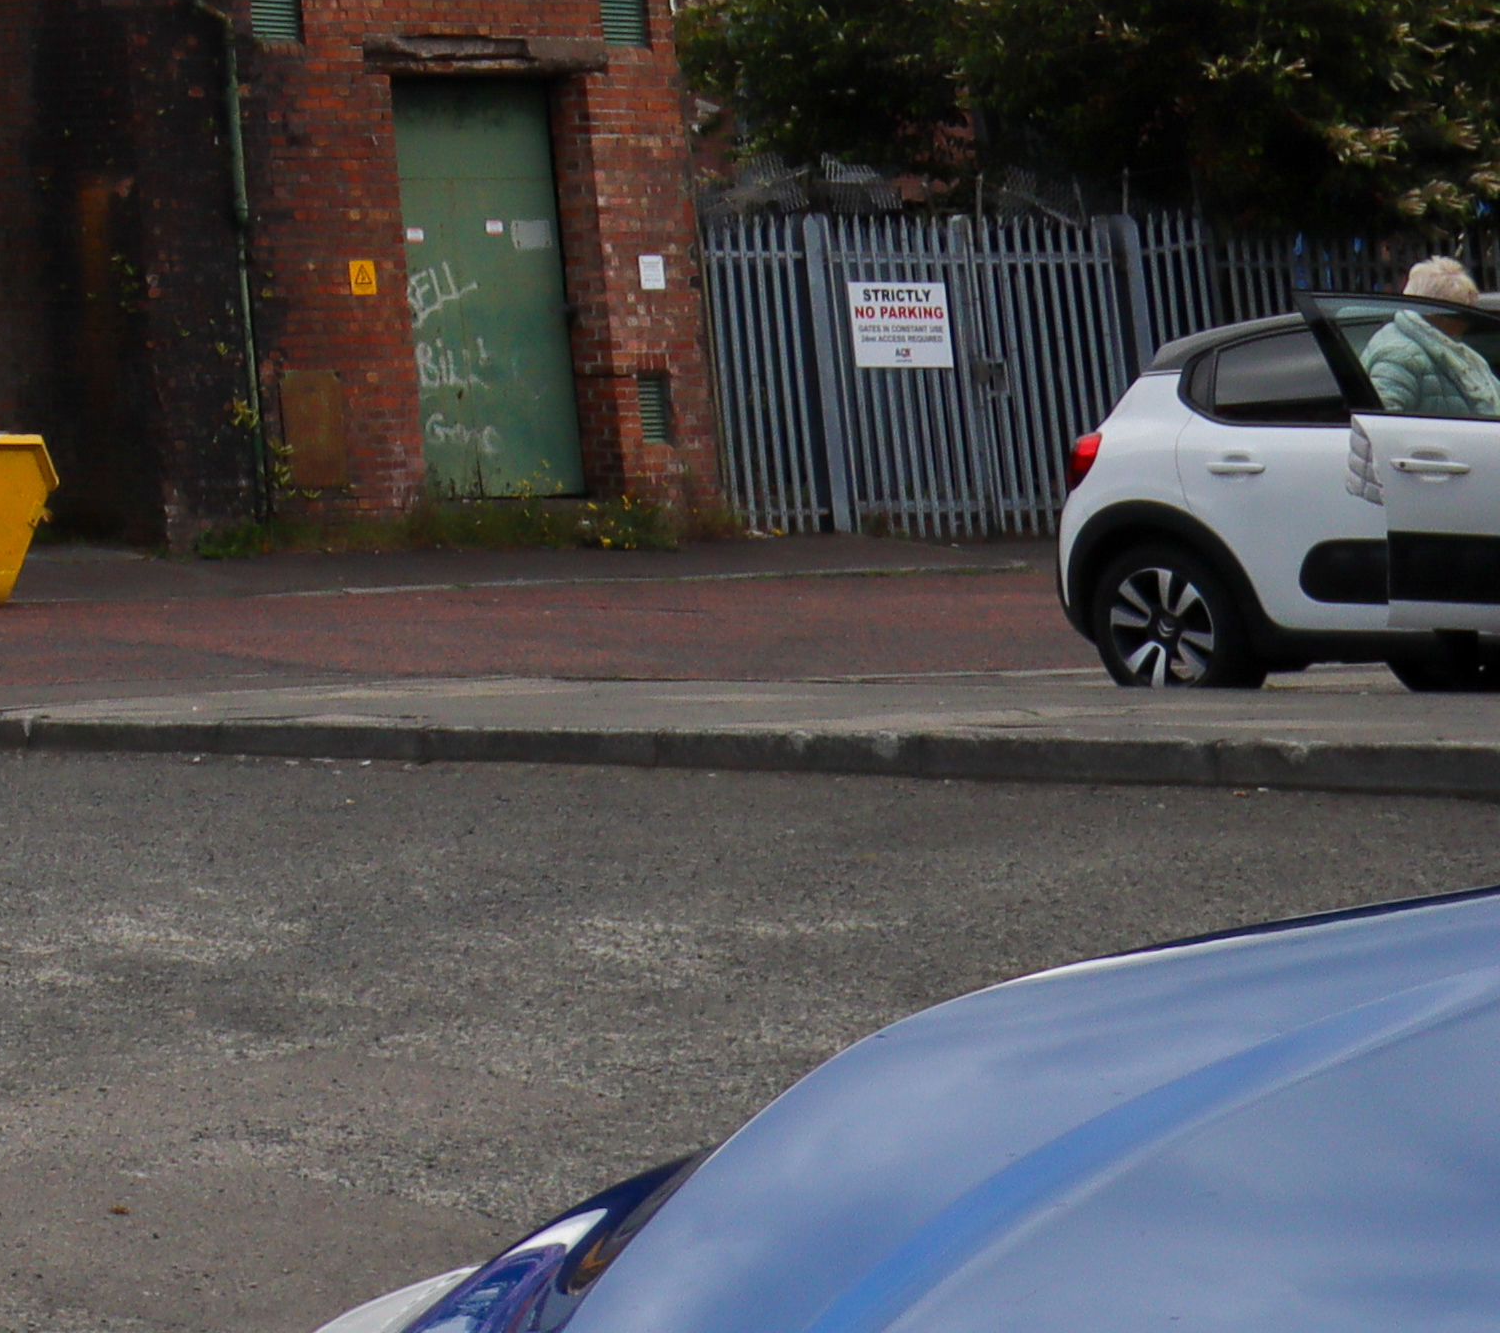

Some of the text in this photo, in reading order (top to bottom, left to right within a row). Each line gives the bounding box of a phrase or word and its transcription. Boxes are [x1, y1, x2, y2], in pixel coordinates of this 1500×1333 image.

[863, 289, 932, 302] STRICTLY
[855, 306, 945, 319] NO PARKING
